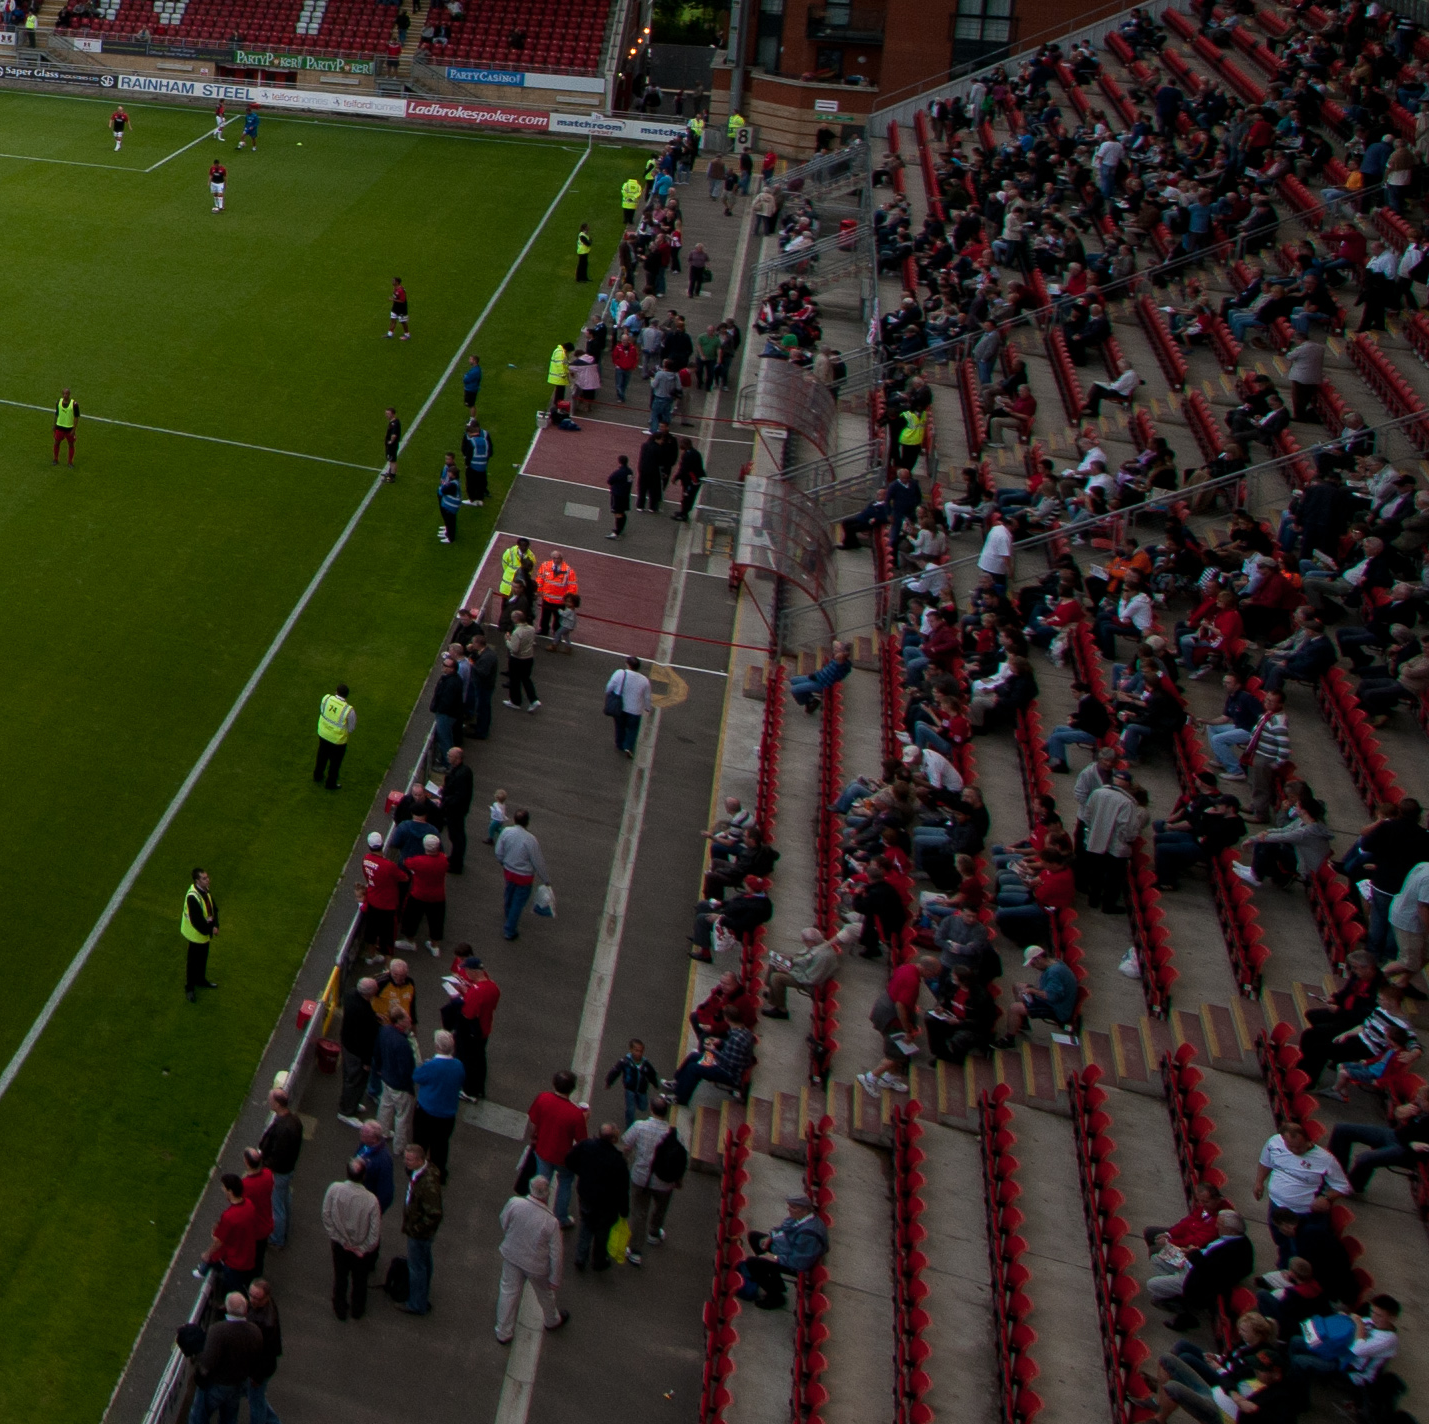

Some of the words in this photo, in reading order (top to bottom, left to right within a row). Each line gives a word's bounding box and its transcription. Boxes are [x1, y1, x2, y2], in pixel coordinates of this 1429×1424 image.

[33, 68, 59, 79] Glass
[121, 77, 195, 95] RAINHAM
[202, 84, 255, 101] STEEL
[407, 102, 548, 126] Ladbrokespoker.com
[556, 118, 622, 131] matchroom
[738, 129, 748, 144] 8
[328, 704, 338, 714] 74
